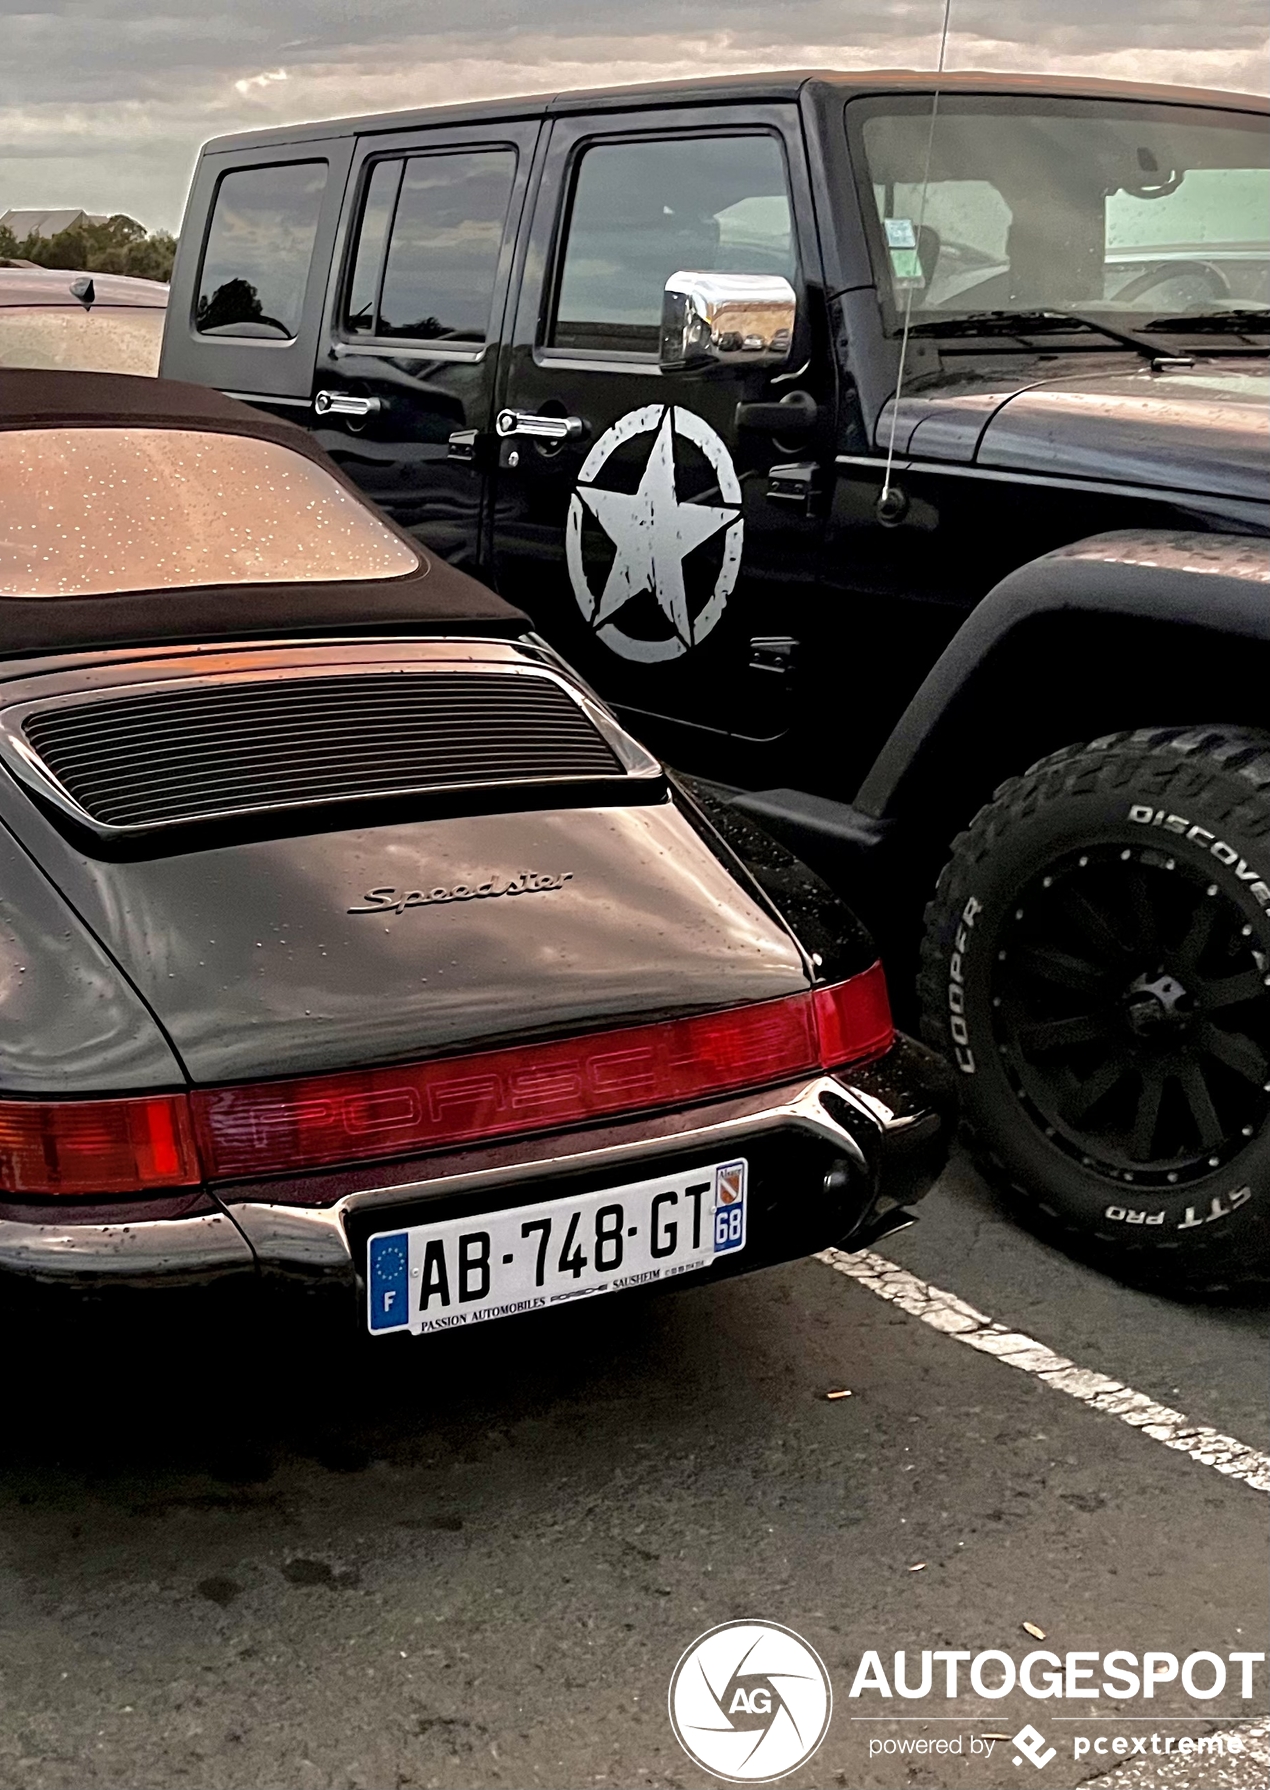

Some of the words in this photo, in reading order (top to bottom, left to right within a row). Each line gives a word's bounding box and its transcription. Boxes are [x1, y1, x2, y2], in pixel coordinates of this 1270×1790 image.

[346, 870, 574, 915] Speedster
[948, 896, 982, 1074] COOPER
[716, 1208, 742, 1244] 68
[1104, 1205, 1166, 1225] PRO
[1177, 1186, 1252, 1230] STT
[418, 1181, 711, 1312] AB-748-GT
[383, 1291, 397, 1312] F
[420, 1313, 468, 1332] PASSION
[471, 1296, 546, 1321] AUTOMOBILES
[612, 1269, 661, 1290] SAUSHEIM
